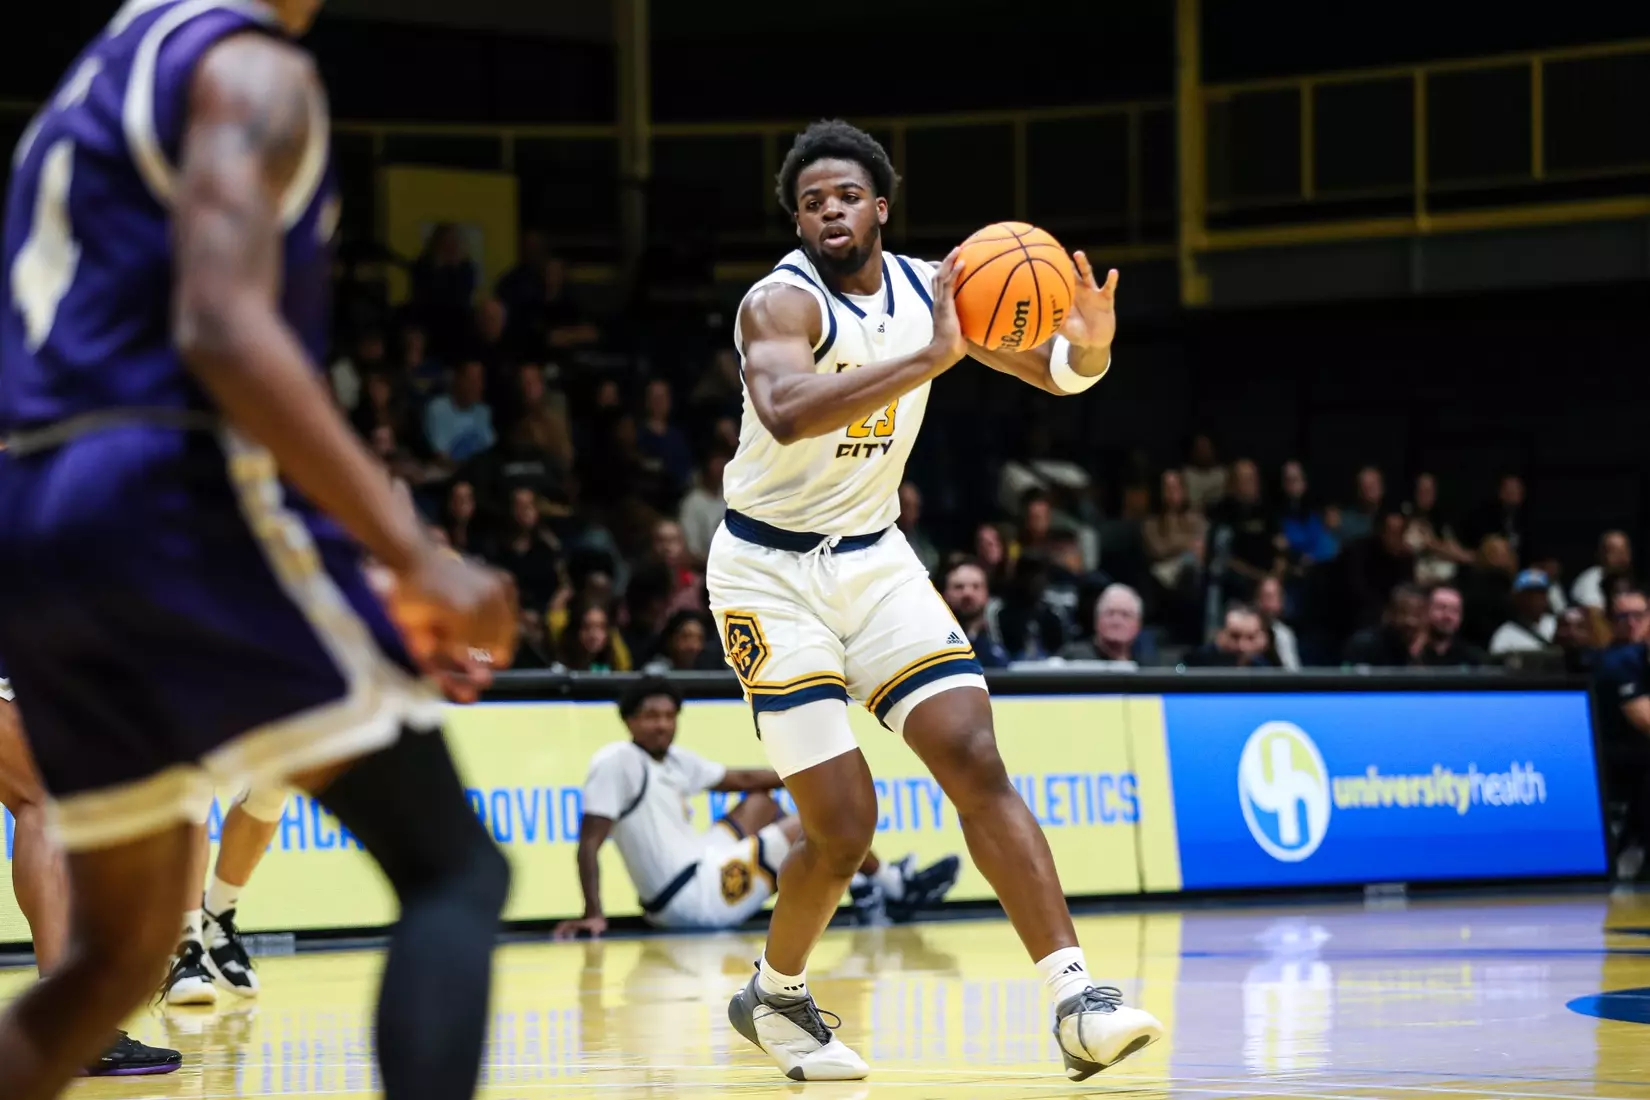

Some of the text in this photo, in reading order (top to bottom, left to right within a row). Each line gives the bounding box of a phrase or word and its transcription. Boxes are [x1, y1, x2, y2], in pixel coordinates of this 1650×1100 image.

[846, 397, 898, 438] 23
[835, 439, 894, 459] CITY
[463, 787, 586, 843] ROVID
[872, 777, 944, 831] CITY
